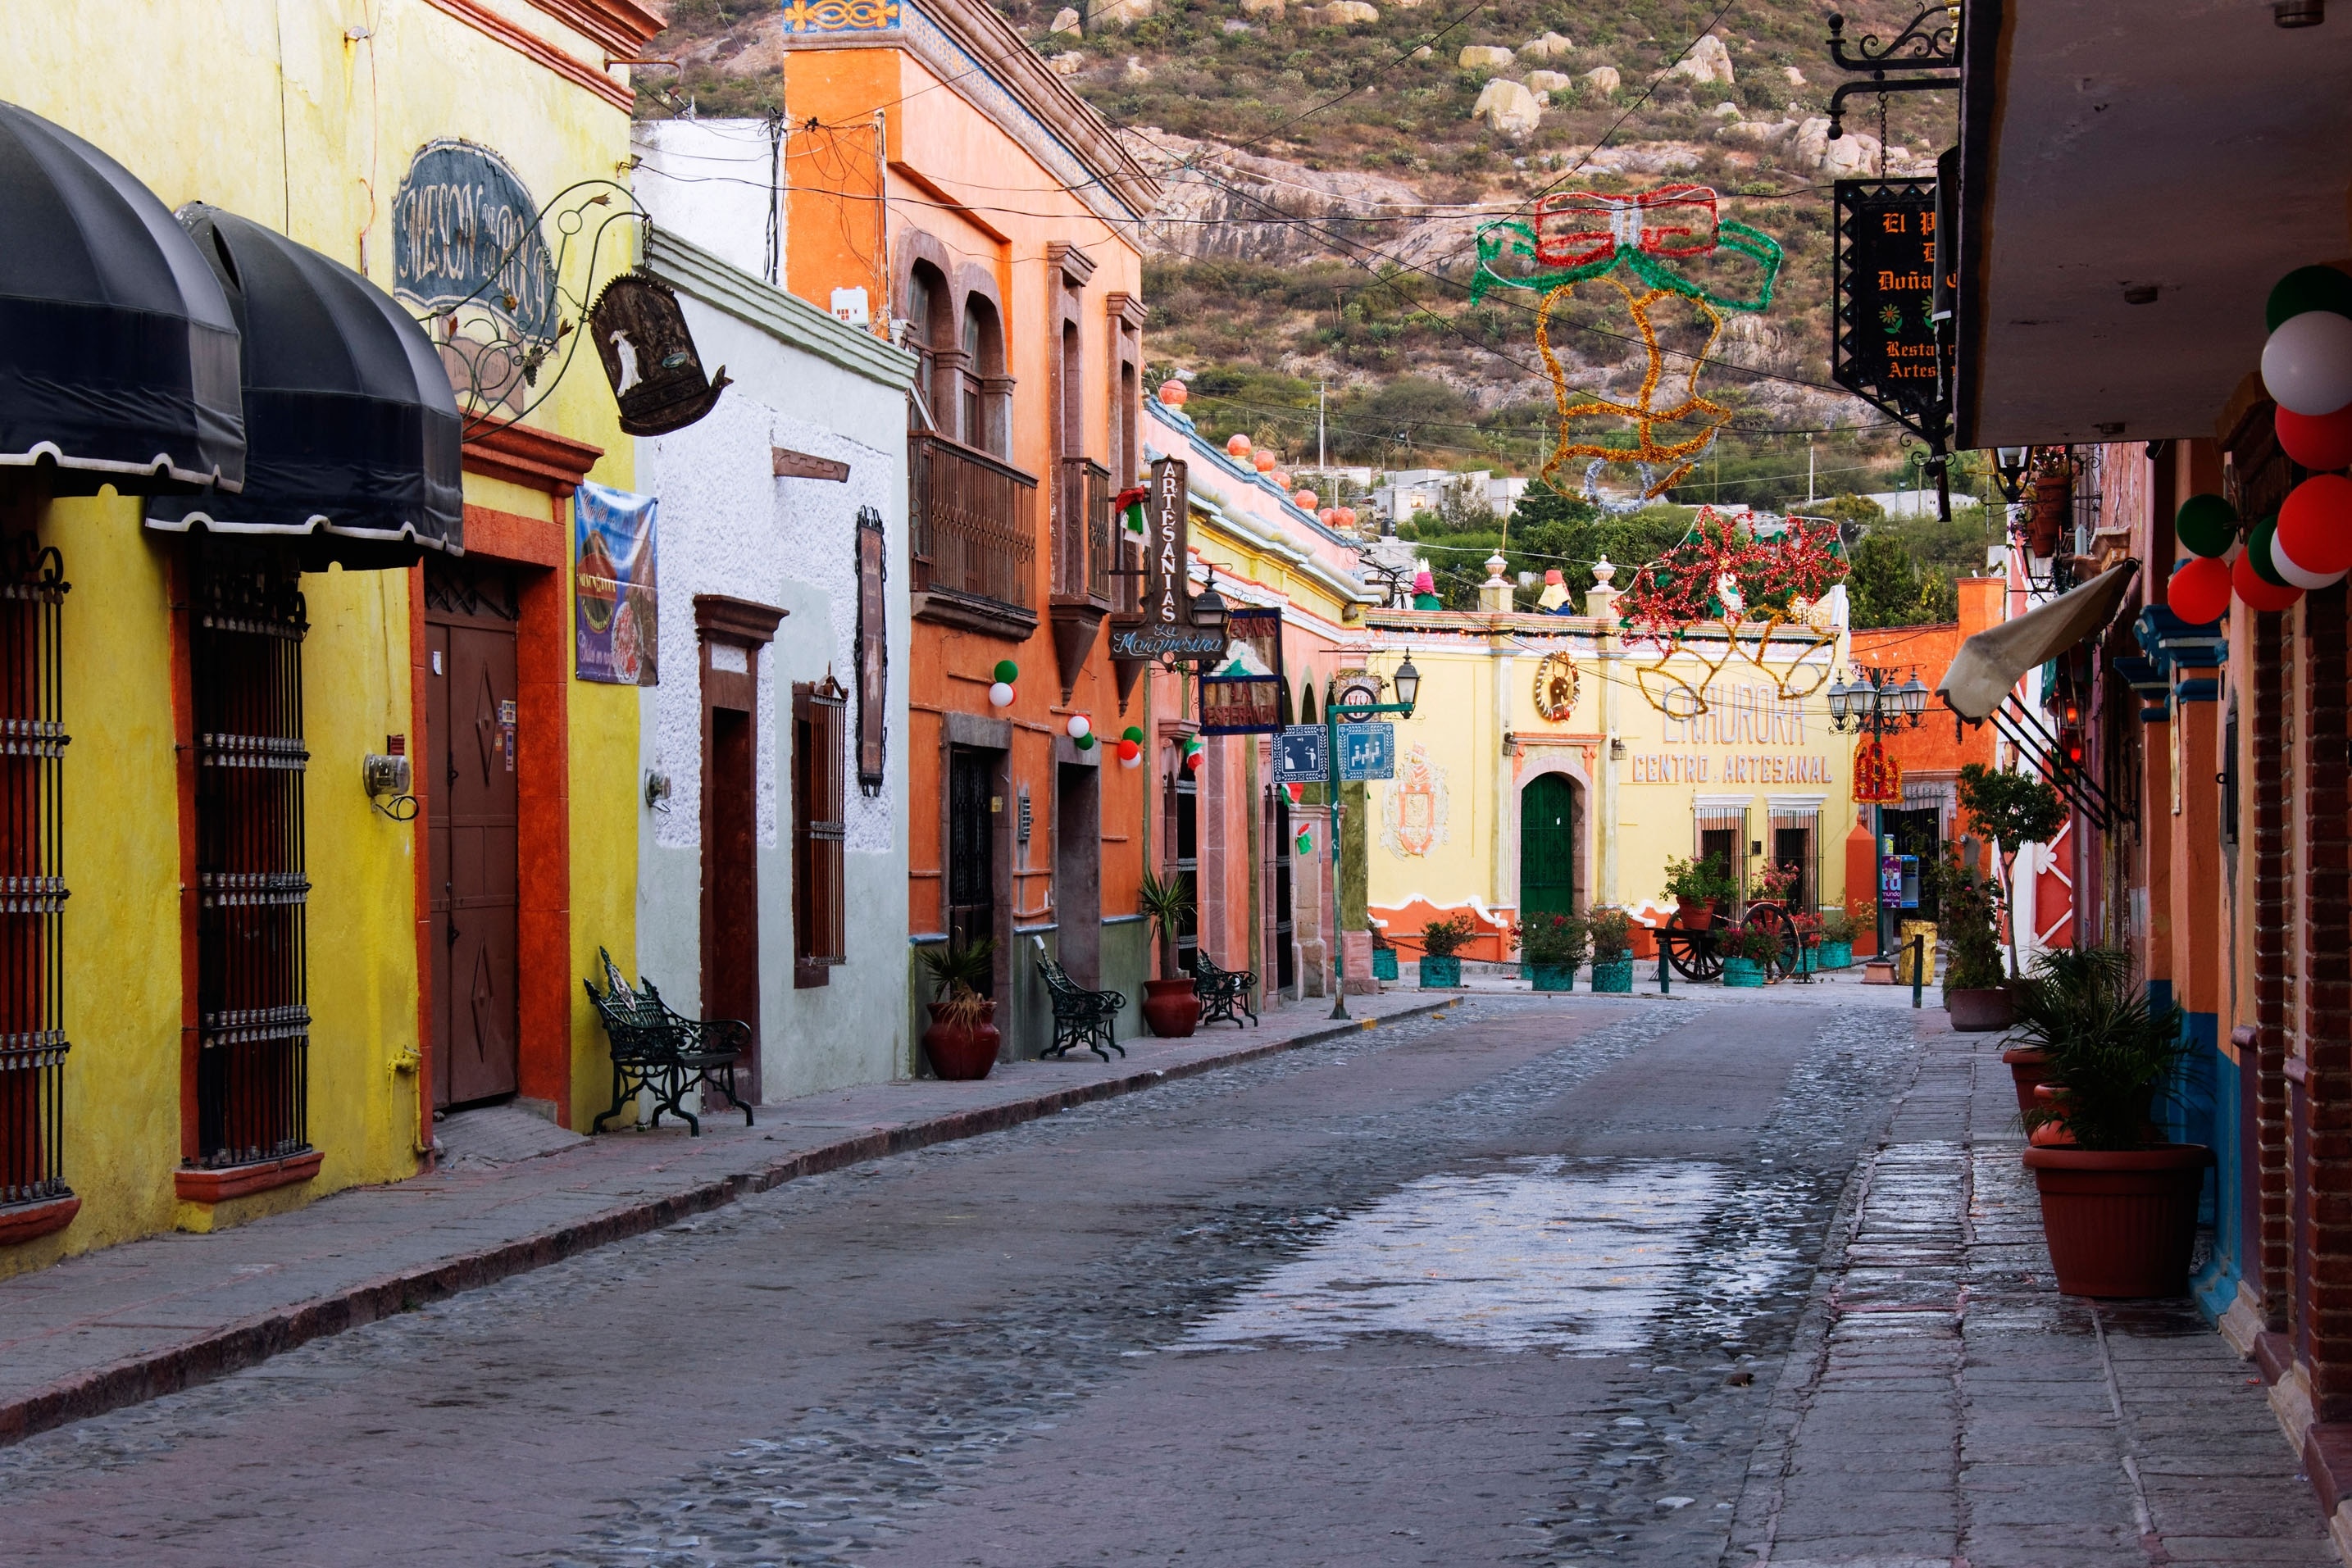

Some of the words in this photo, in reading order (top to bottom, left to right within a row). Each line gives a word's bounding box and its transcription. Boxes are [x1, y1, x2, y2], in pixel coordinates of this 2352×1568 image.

[1883, 211, 1906, 233] El
[399, 182, 483, 283] MESON
[482, 203, 496, 235] DE
[497, 204, 545, 325] ROCA
[1878, 270, 1933, 291] Doña
[1161, 462, 1178, 622] ARTESANIAS
[1154, 624, 1179, 637] La
[1113, 631, 1223, 658] Marquesina
[1231, 682, 1252, 702] LA
[1205, 704, 1277, 726] ESPERANZA
[1702, 682, 1806, 746] AURORA
[1632, 754, 1708, 783] CENTRO
[1722, 754, 1833, 784] ARTESANAL
